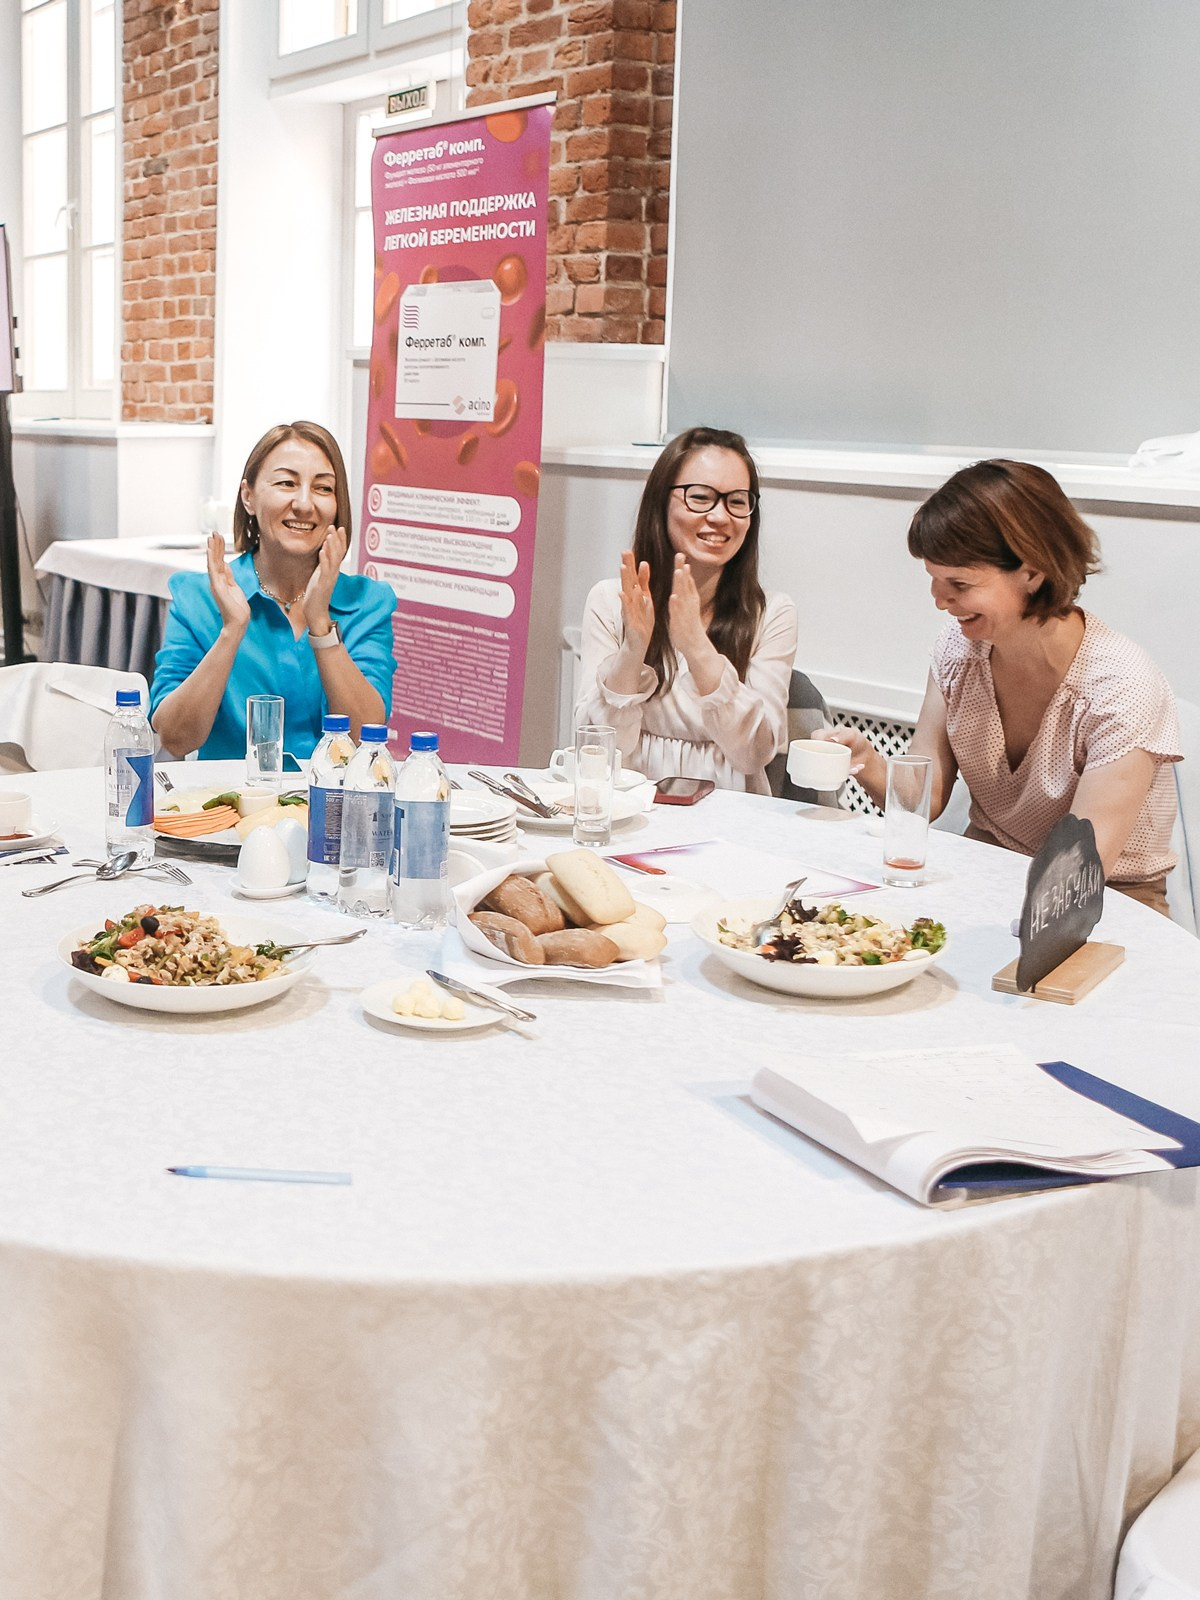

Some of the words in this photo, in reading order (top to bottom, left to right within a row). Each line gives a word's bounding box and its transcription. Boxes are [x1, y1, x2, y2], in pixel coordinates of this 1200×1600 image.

[390, 89, 427, 112] ВЫХОД
[449, 138, 486, 156] комп.
[384, 202, 448, 226] ЖЕЛЕЗНАЯ
[450, 191, 536, 218] ПОДДЕРЖКА
[384, 228, 428, 251] ЛЕГКОЙ
[430, 219, 536, 247] БЕРЕМЕННОСТИ
[459, 336, 487, 348] комп.
[468, 397, 491, 411] acino
